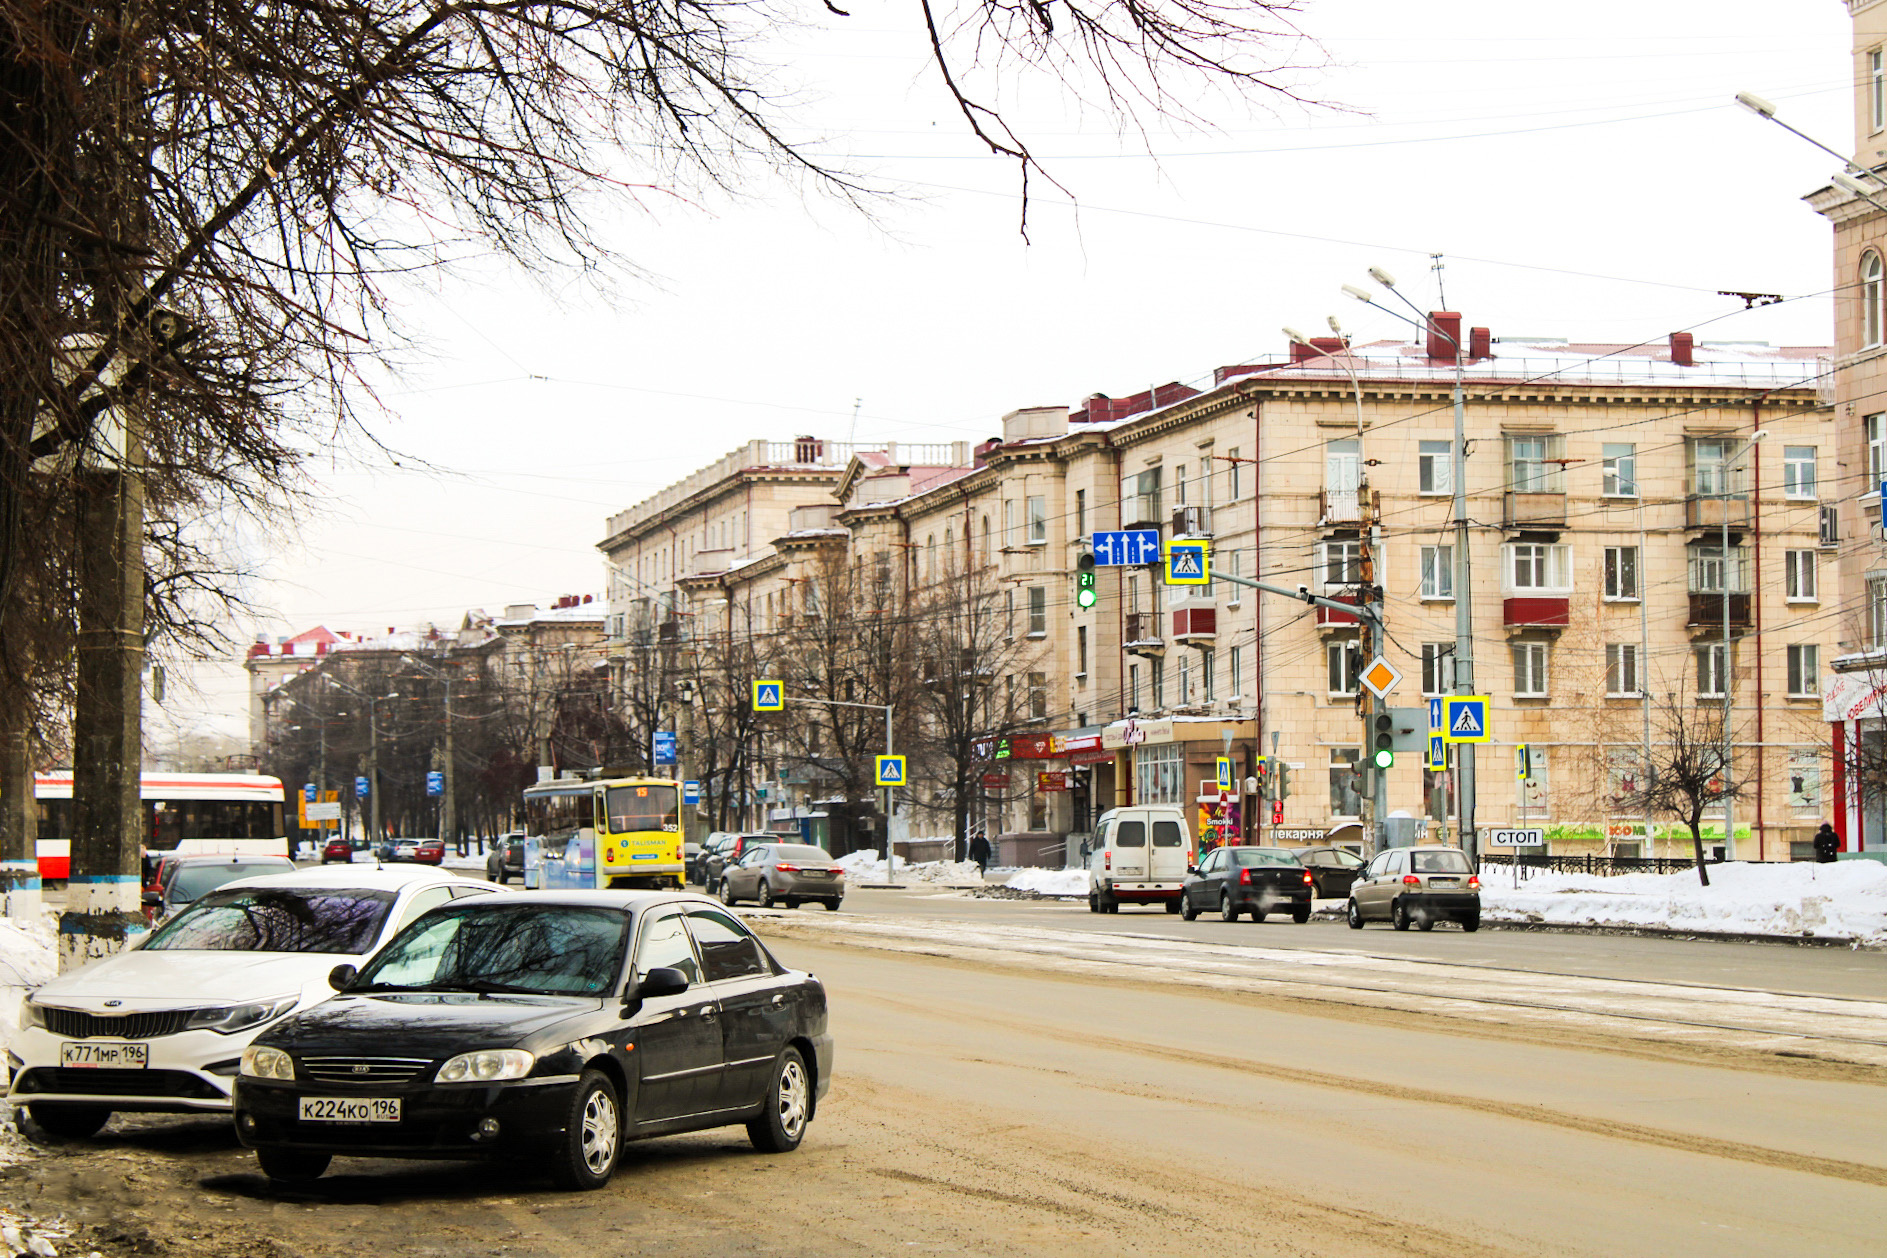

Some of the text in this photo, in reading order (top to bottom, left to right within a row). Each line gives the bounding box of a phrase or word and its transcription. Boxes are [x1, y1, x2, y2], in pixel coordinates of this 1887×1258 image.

[1082, 573, 1093, 586] 21
[636, 787, 648, 797] 15
[663, 824, 678, 832] 352
[1270, 830, 1324, 841] пекарня
[1497, 832, 1537, 843] СТОП
[122, 1046, 142, 1058] 196
[372, 1100, 397, 1114] 196
